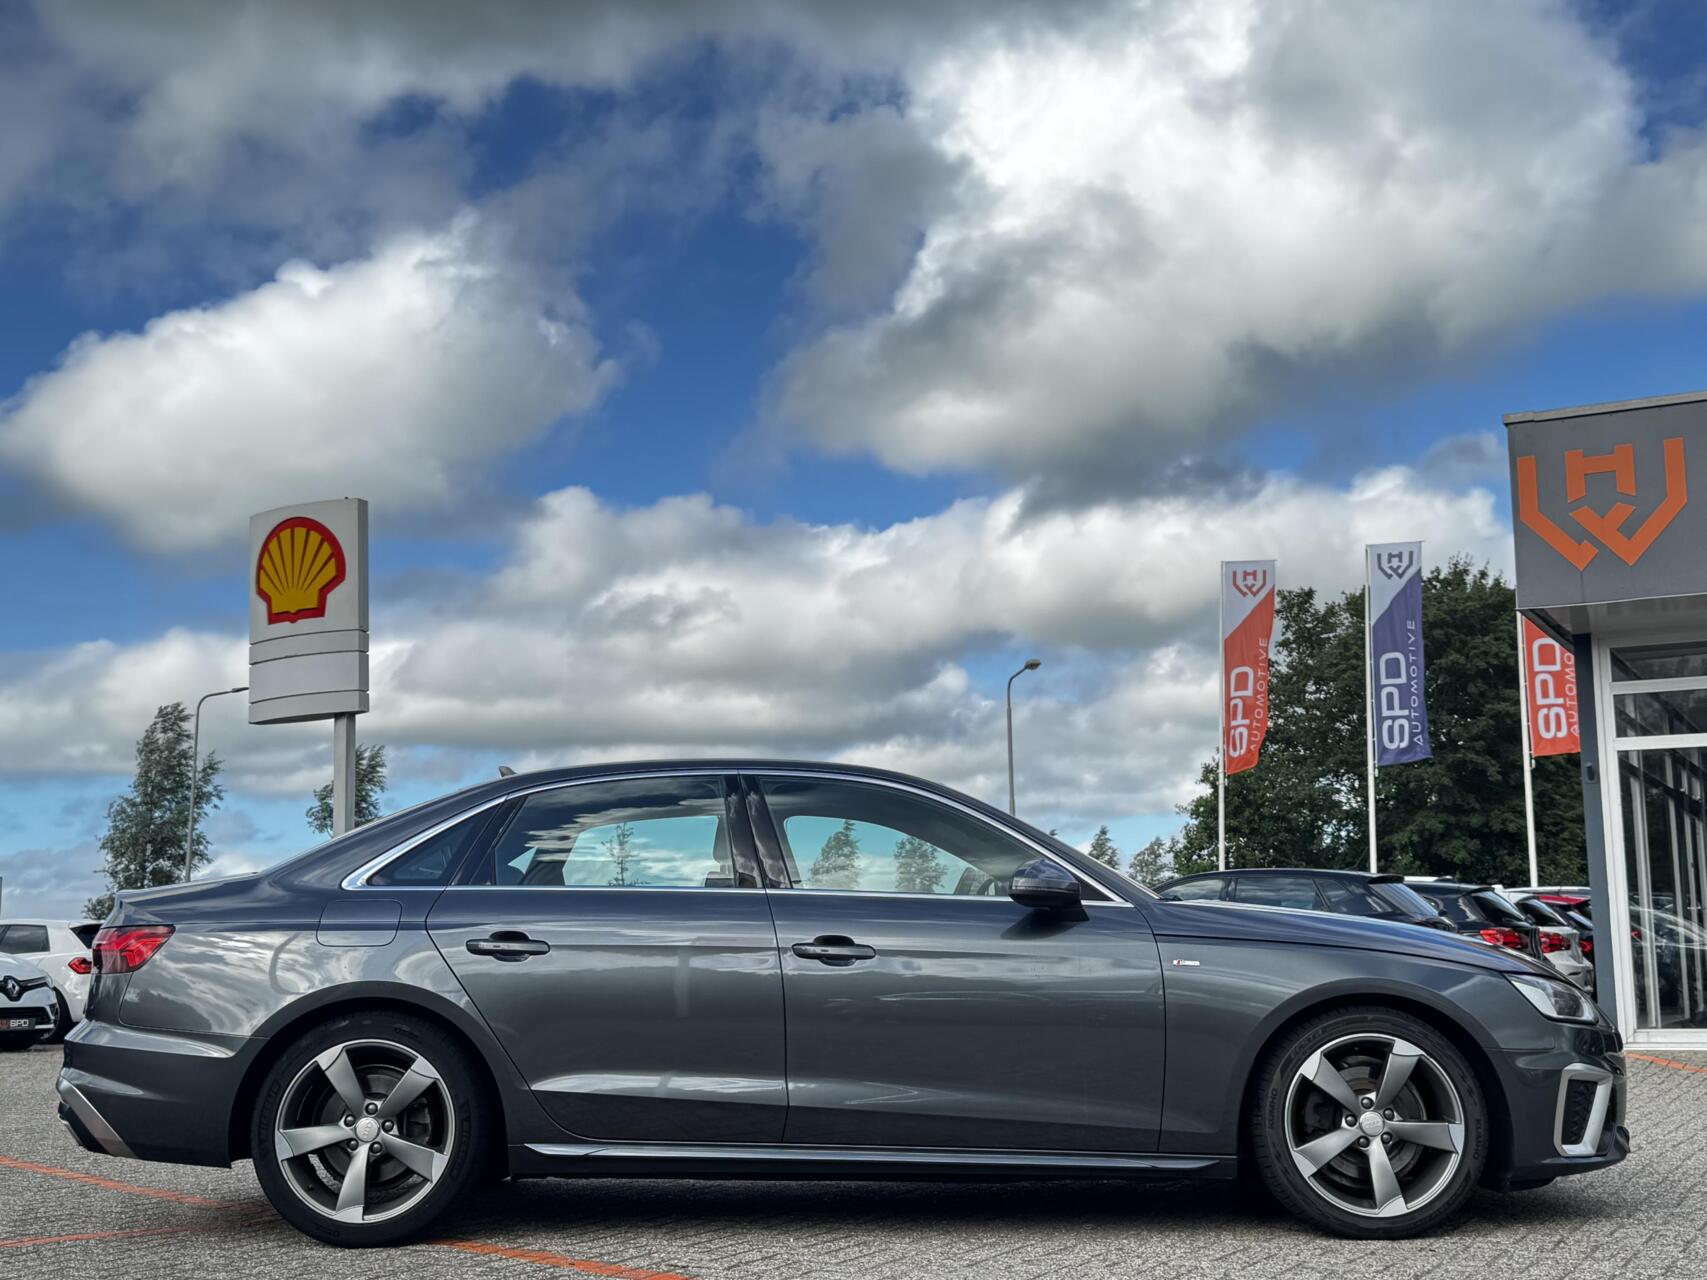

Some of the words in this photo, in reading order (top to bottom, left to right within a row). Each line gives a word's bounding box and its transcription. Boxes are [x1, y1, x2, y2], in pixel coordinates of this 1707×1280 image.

[1229, 666, 1253, 758] SPD
[1380, 651, 1410, 750] SPD
[1407, 620, 1424, 745] AUTOMOTIVE
[1532, 637, 1568, 739] SPD
